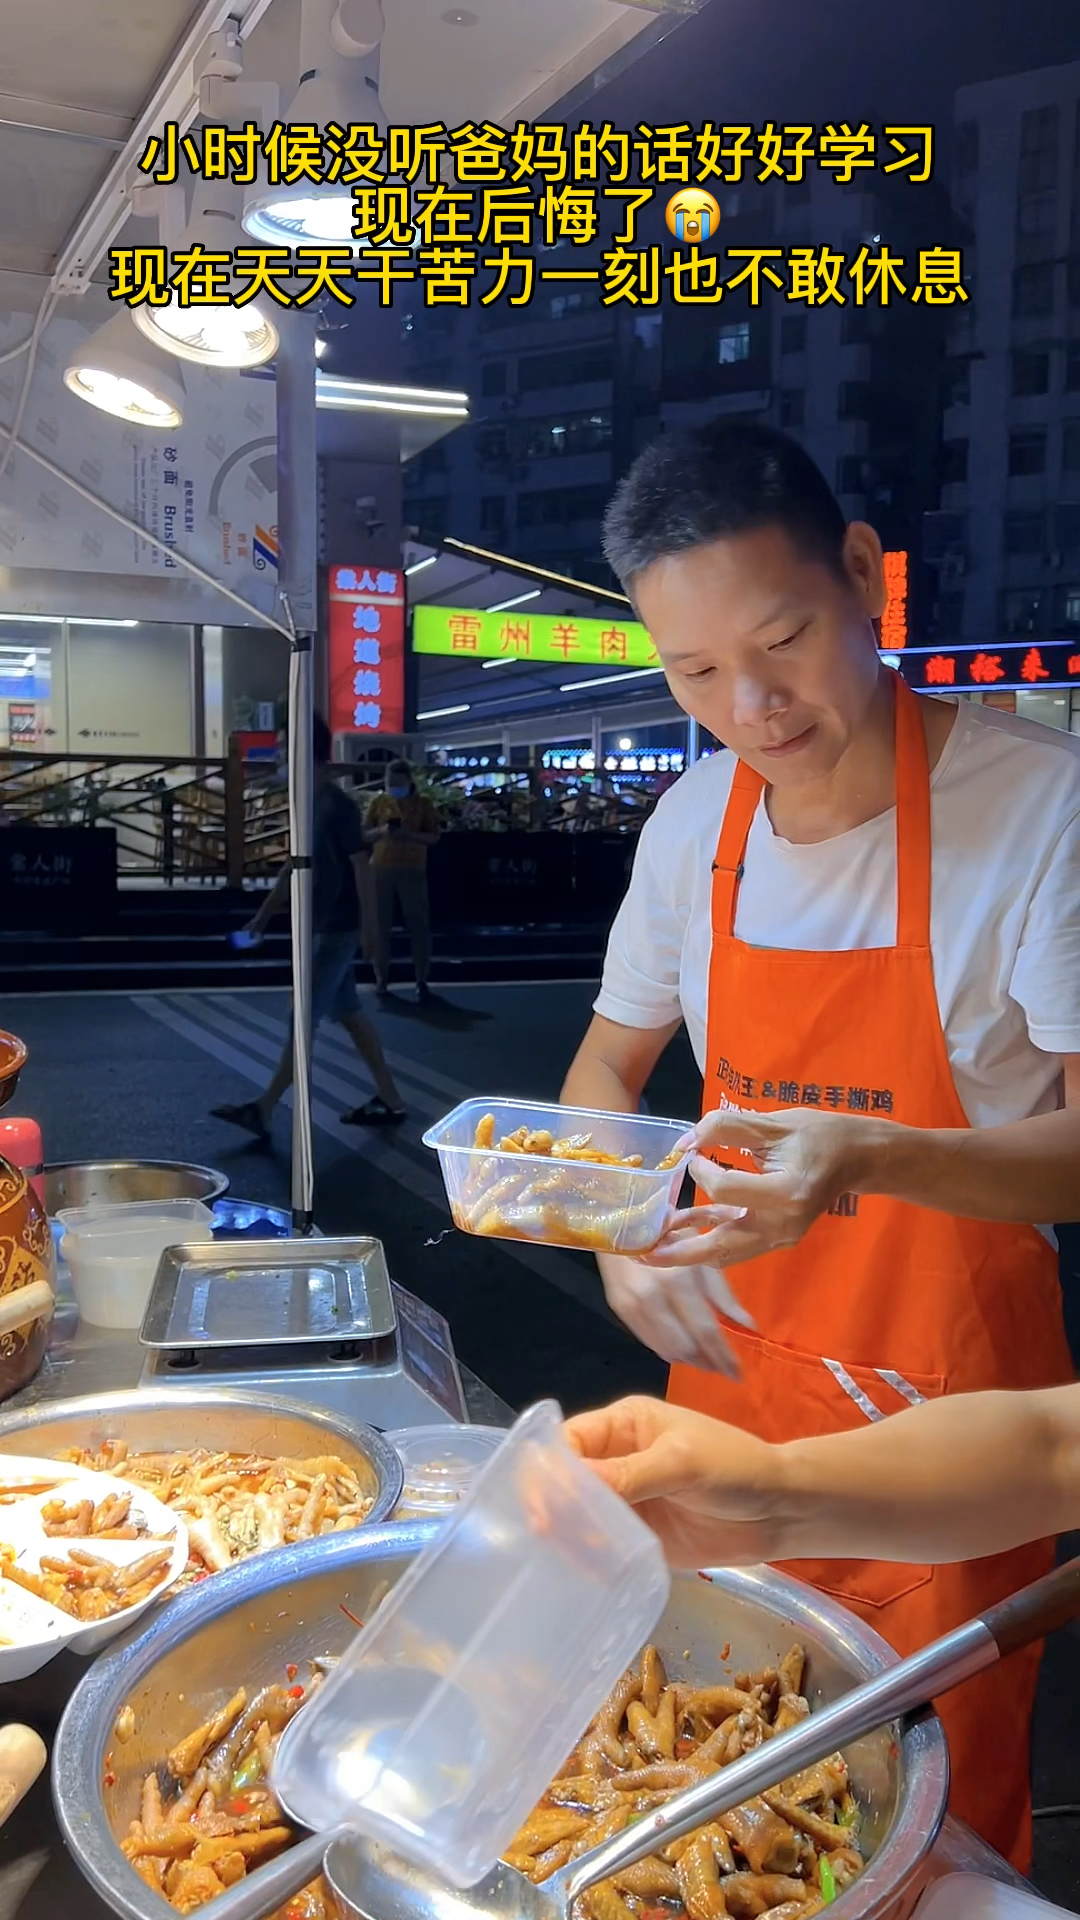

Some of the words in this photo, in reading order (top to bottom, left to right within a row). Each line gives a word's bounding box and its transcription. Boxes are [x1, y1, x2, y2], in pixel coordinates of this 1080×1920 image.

[163, 505, 177, 568] Brushd
[448, 615, 660, 660] 雷州羊肉
